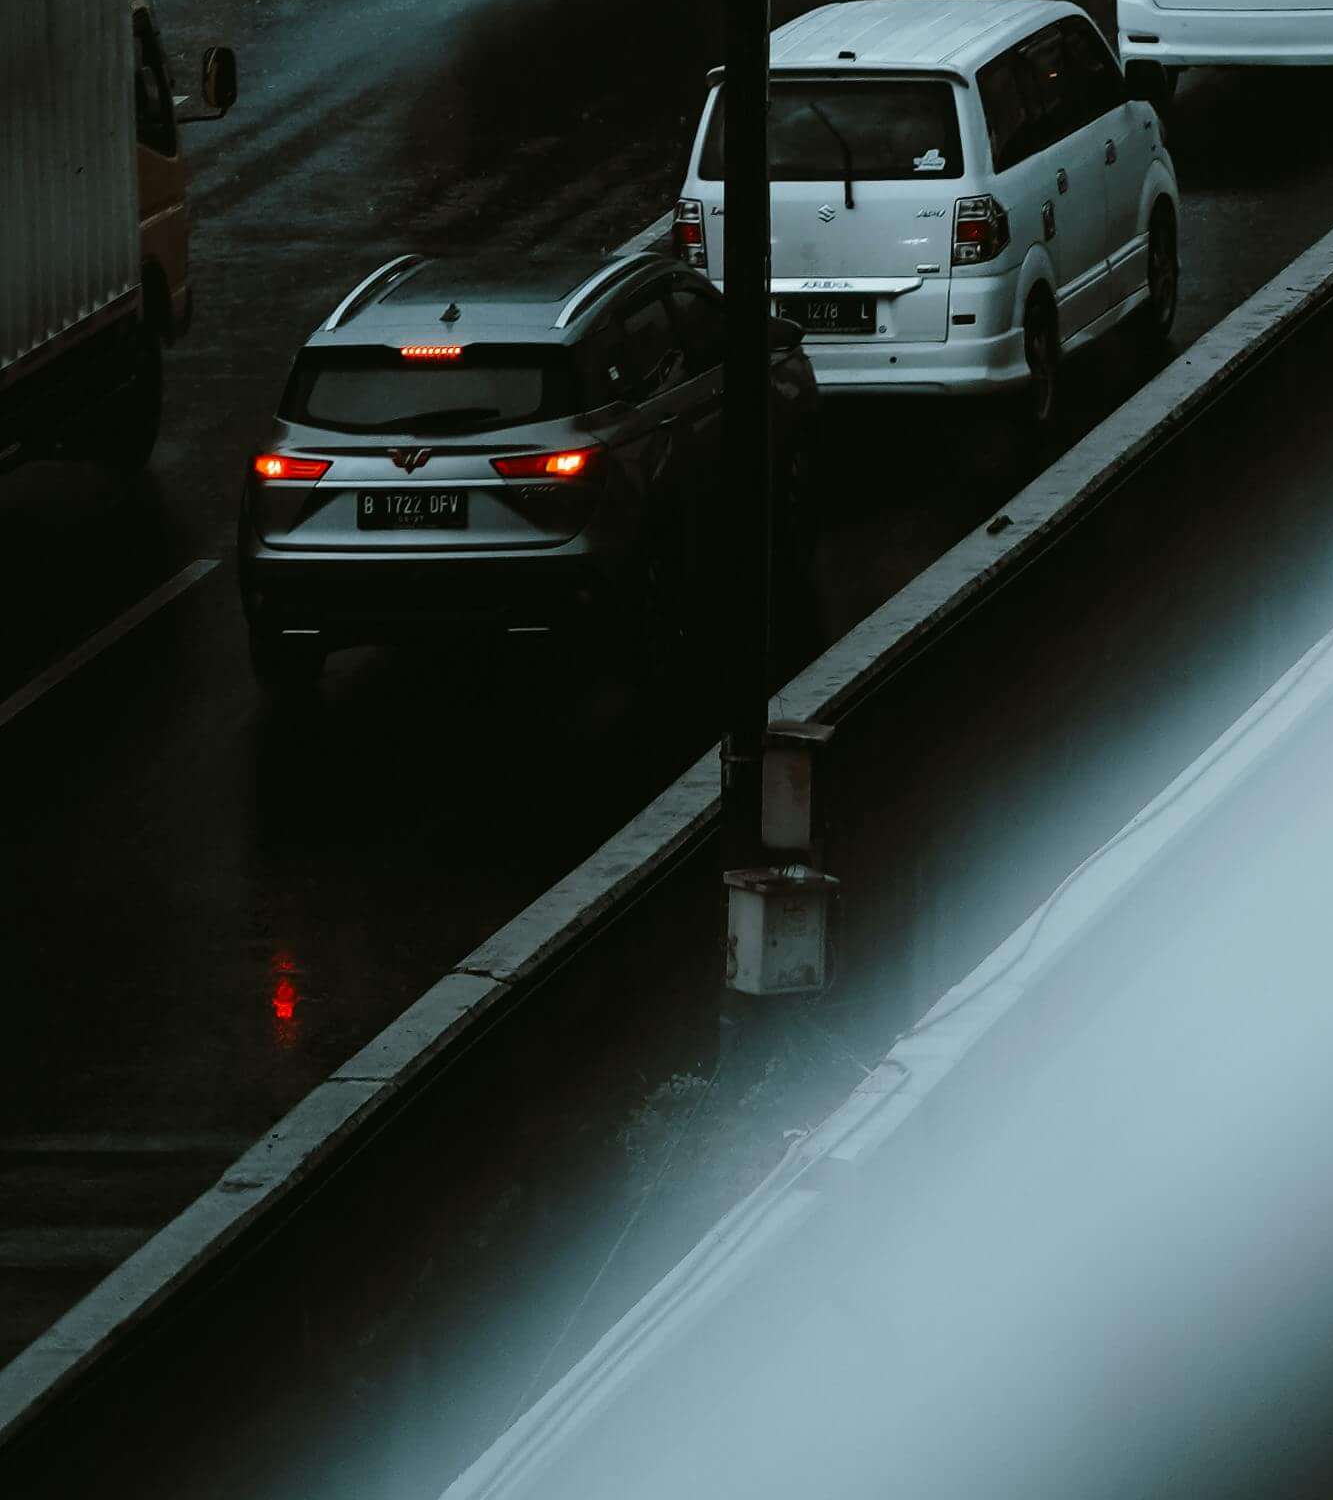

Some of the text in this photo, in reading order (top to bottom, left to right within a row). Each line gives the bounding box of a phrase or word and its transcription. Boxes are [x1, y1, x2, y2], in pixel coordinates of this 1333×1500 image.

[363, 494, 459, 515] B 1722 DFV
